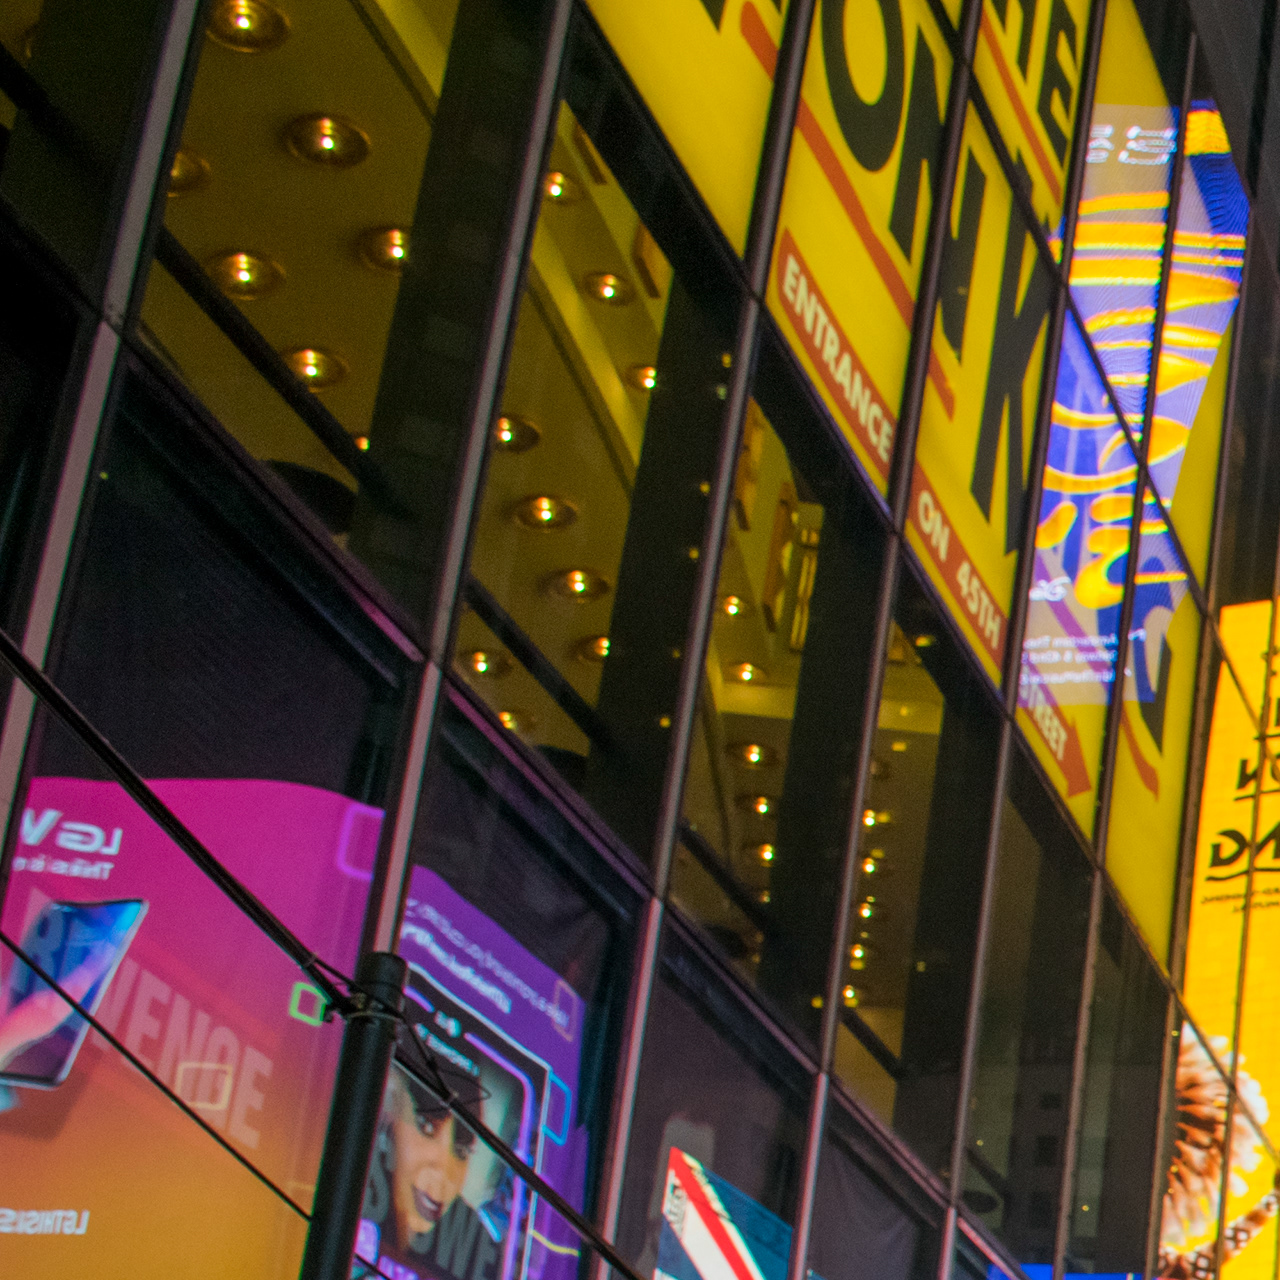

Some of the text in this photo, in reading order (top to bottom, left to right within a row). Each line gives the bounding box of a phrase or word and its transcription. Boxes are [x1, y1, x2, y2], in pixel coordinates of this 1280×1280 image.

[783, 253, 893, 458] ENTRANCE
[918, 489, 949, 562] ON
[957, 561, 1000, 650] 45TH
